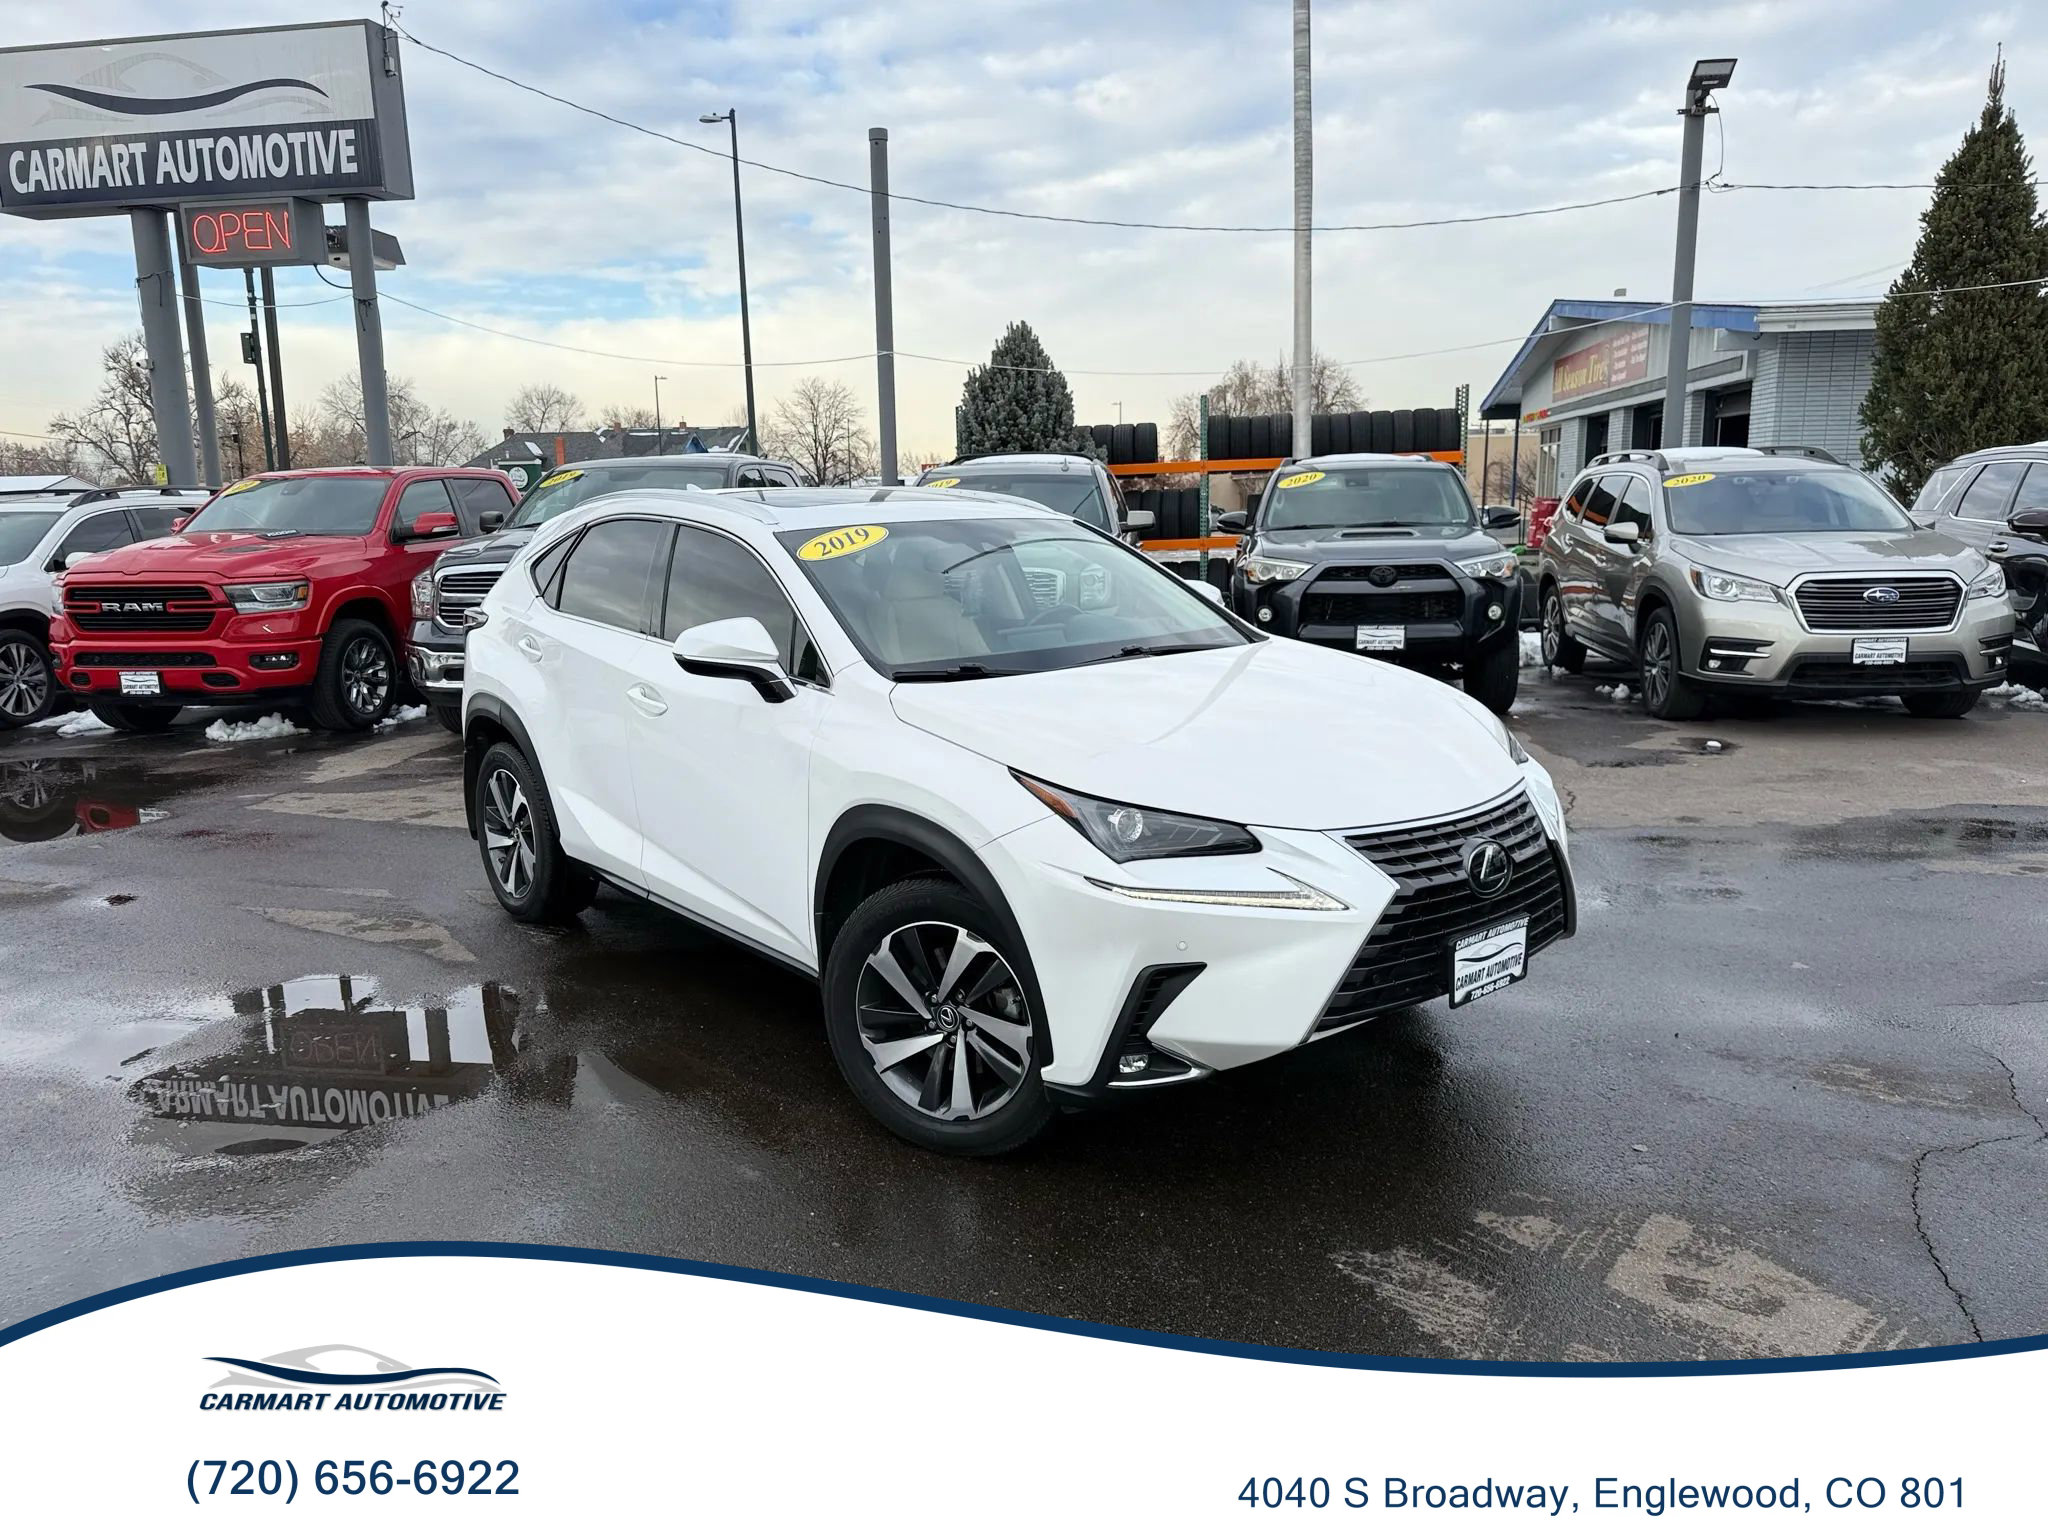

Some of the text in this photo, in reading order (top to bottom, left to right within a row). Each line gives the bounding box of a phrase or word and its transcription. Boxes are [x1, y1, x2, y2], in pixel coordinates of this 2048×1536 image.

[9, 129, 359, 194] CARMART AUTOMOTIVE
[193, 211, 291, 253] OPEN
[1287, 474, 1317, 486] 2020
[1673, 475, 1706, 486] 2020
[814, 528, 870, 556] 2019
[101, 602, 163, 611] RAM
[1456, 917, 1530, 951] CARMART AUTOMOTIVE
[1456, 952, 1523, 991] CARMART AUTOMOTIVE
